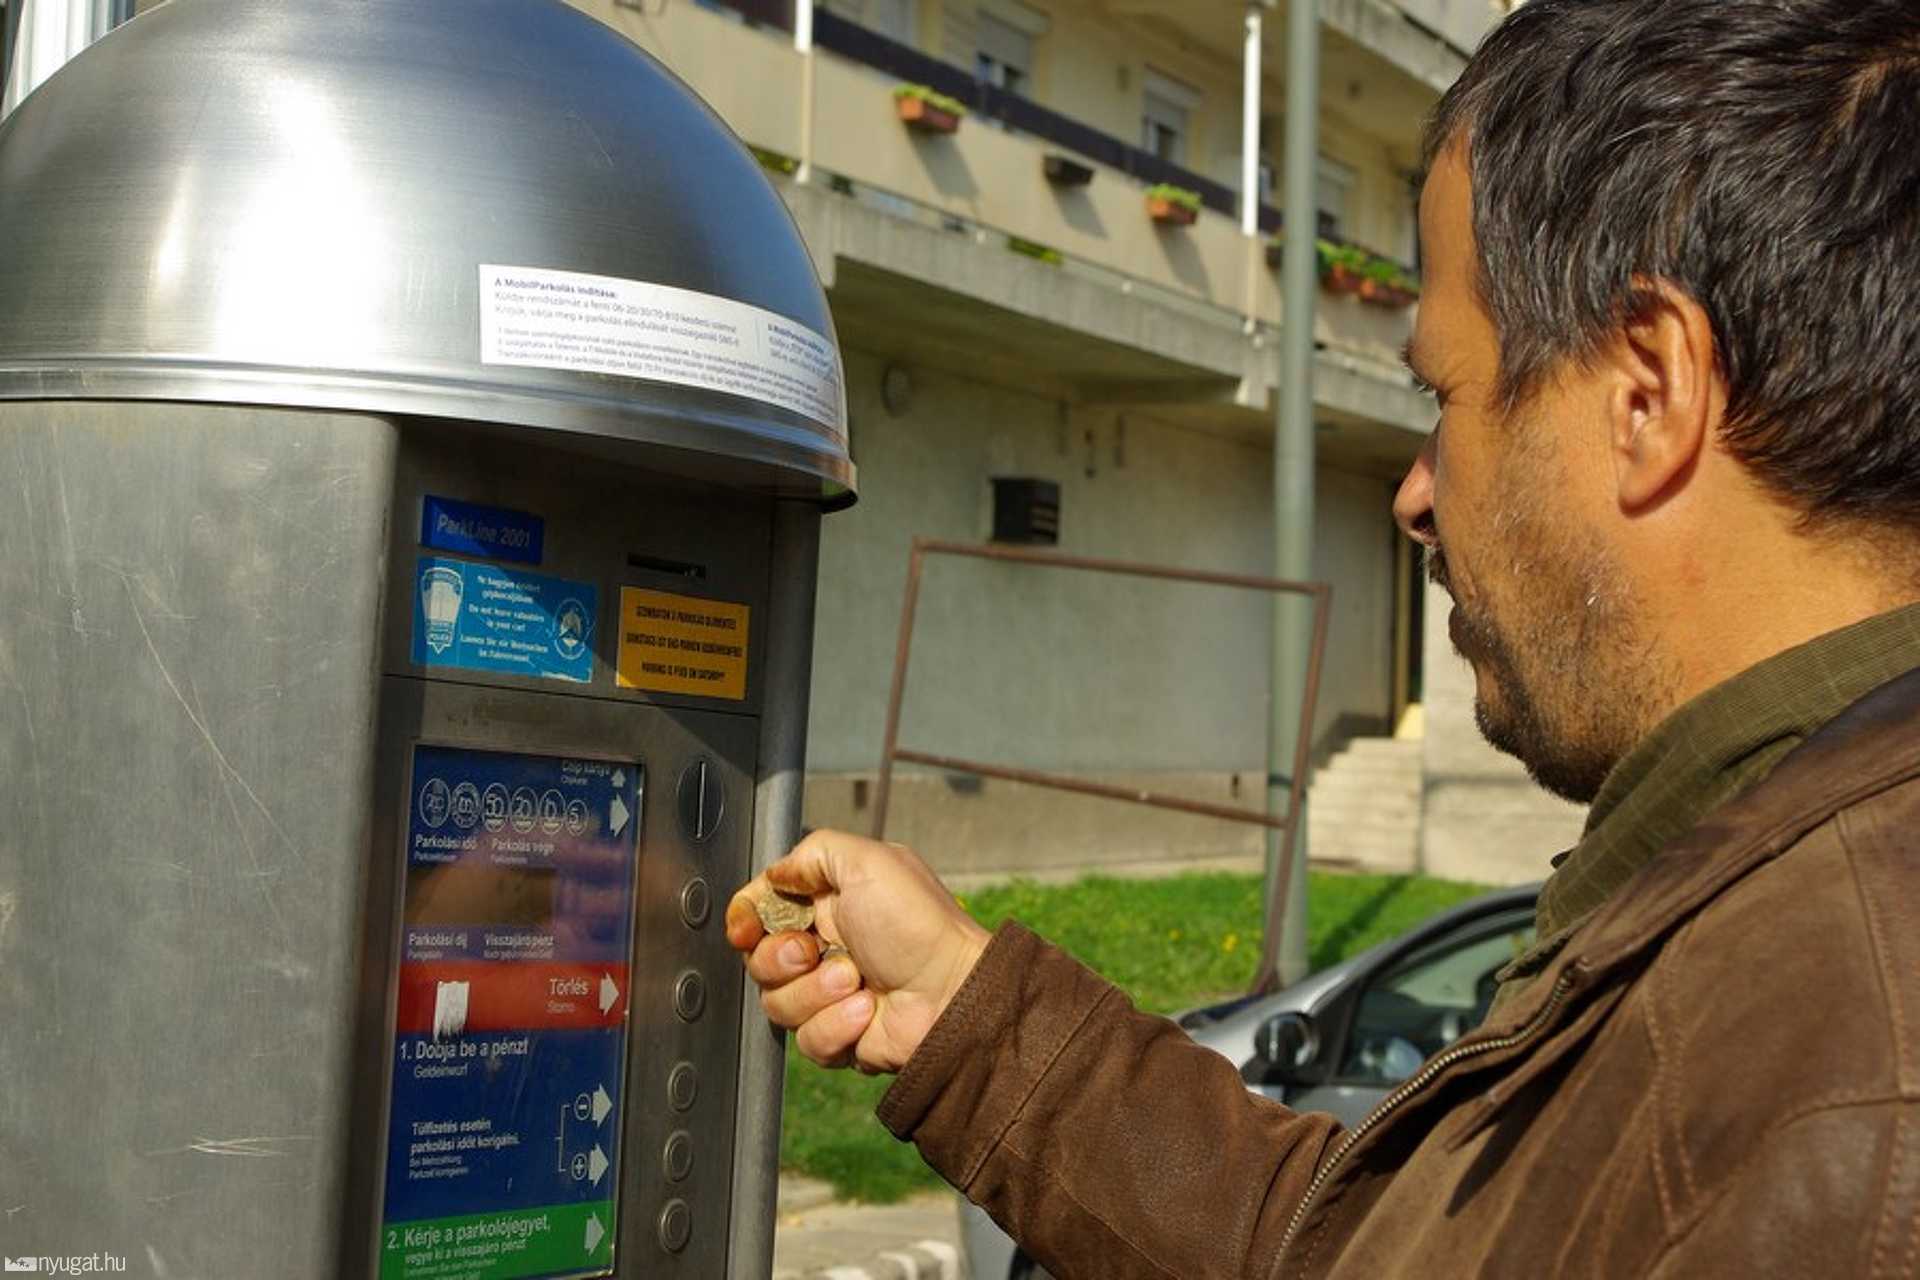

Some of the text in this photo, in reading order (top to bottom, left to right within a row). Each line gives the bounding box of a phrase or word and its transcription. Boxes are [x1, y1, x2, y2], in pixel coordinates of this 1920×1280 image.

[549, 976, 589, 996] Törlés
[416, 1040, 457, 1063] Dobja
[459, 1041, 477, 1057] be
[480, 1042, 489, 1057] a
[387, 1230, 400, 1249] 2.
[404, 1225, 442, 1249] Kérje
[443, 1227, 454, 1243] a
